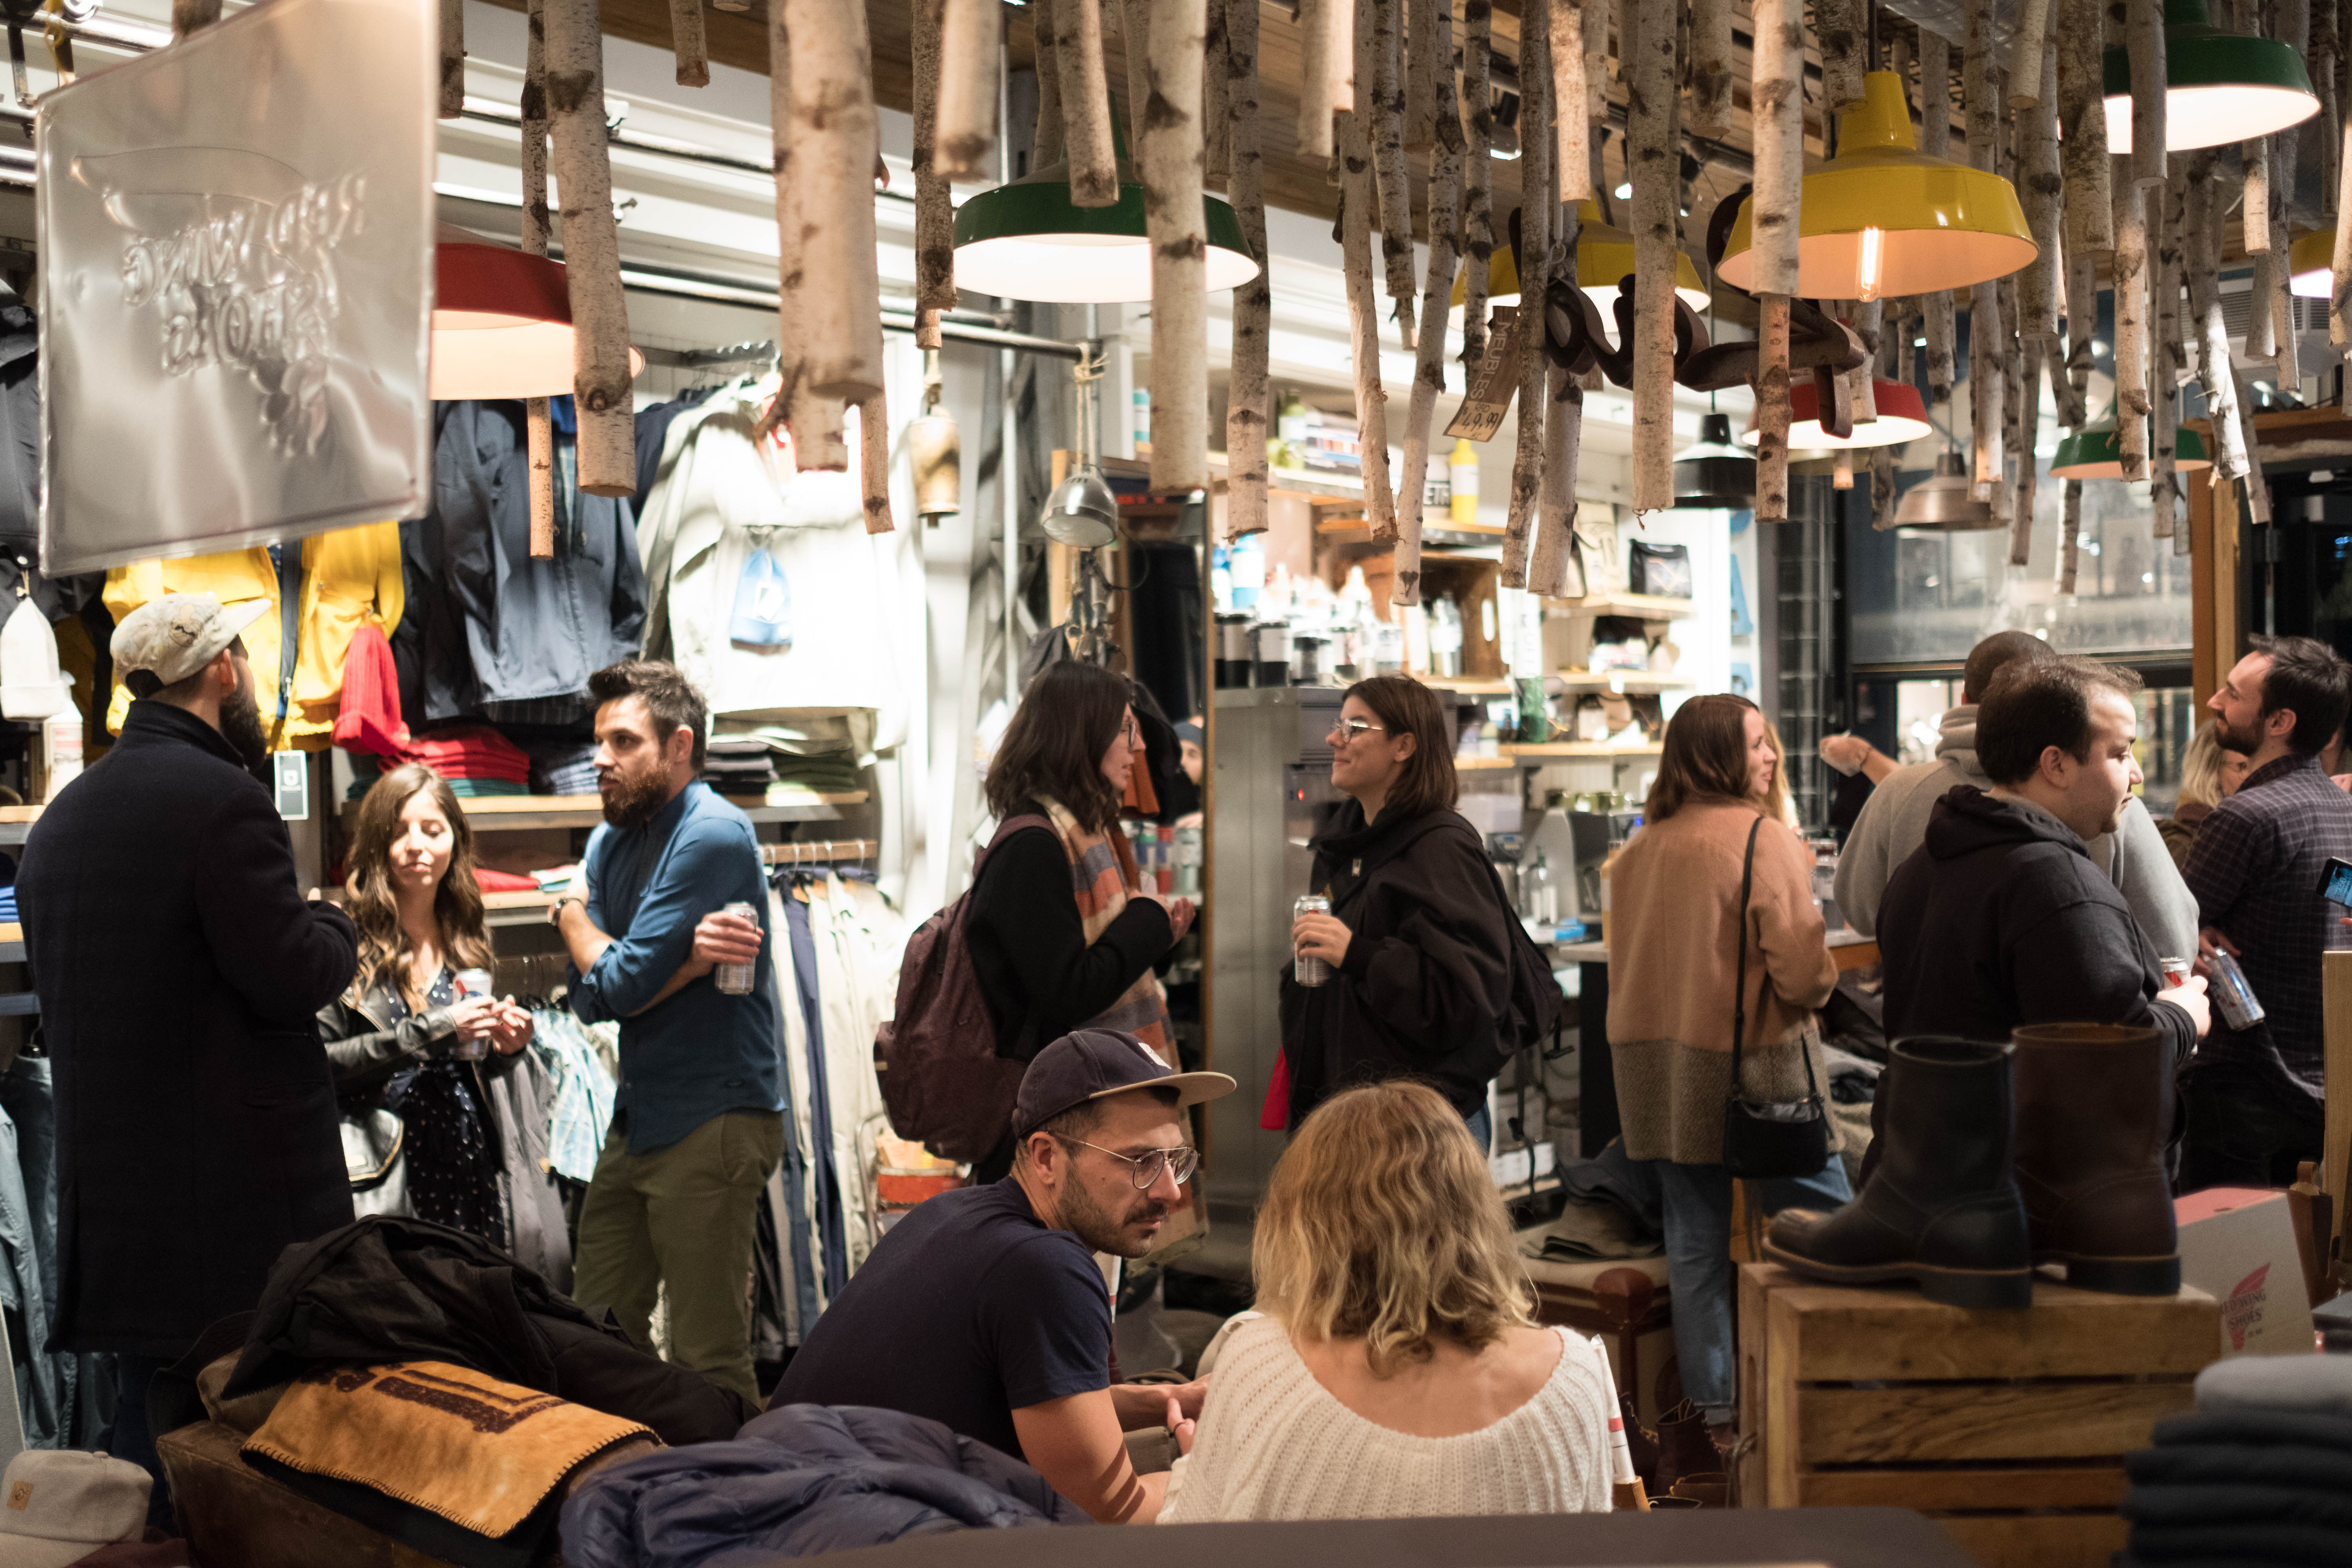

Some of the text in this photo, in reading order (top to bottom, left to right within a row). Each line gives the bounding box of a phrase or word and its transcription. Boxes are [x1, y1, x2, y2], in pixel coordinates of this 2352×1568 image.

[1470, 321, 1512, 399] MEUBLES
[2238, 1289, 2266, 1306] WING
[2228, 1310, 2261, 1330] SHOES
